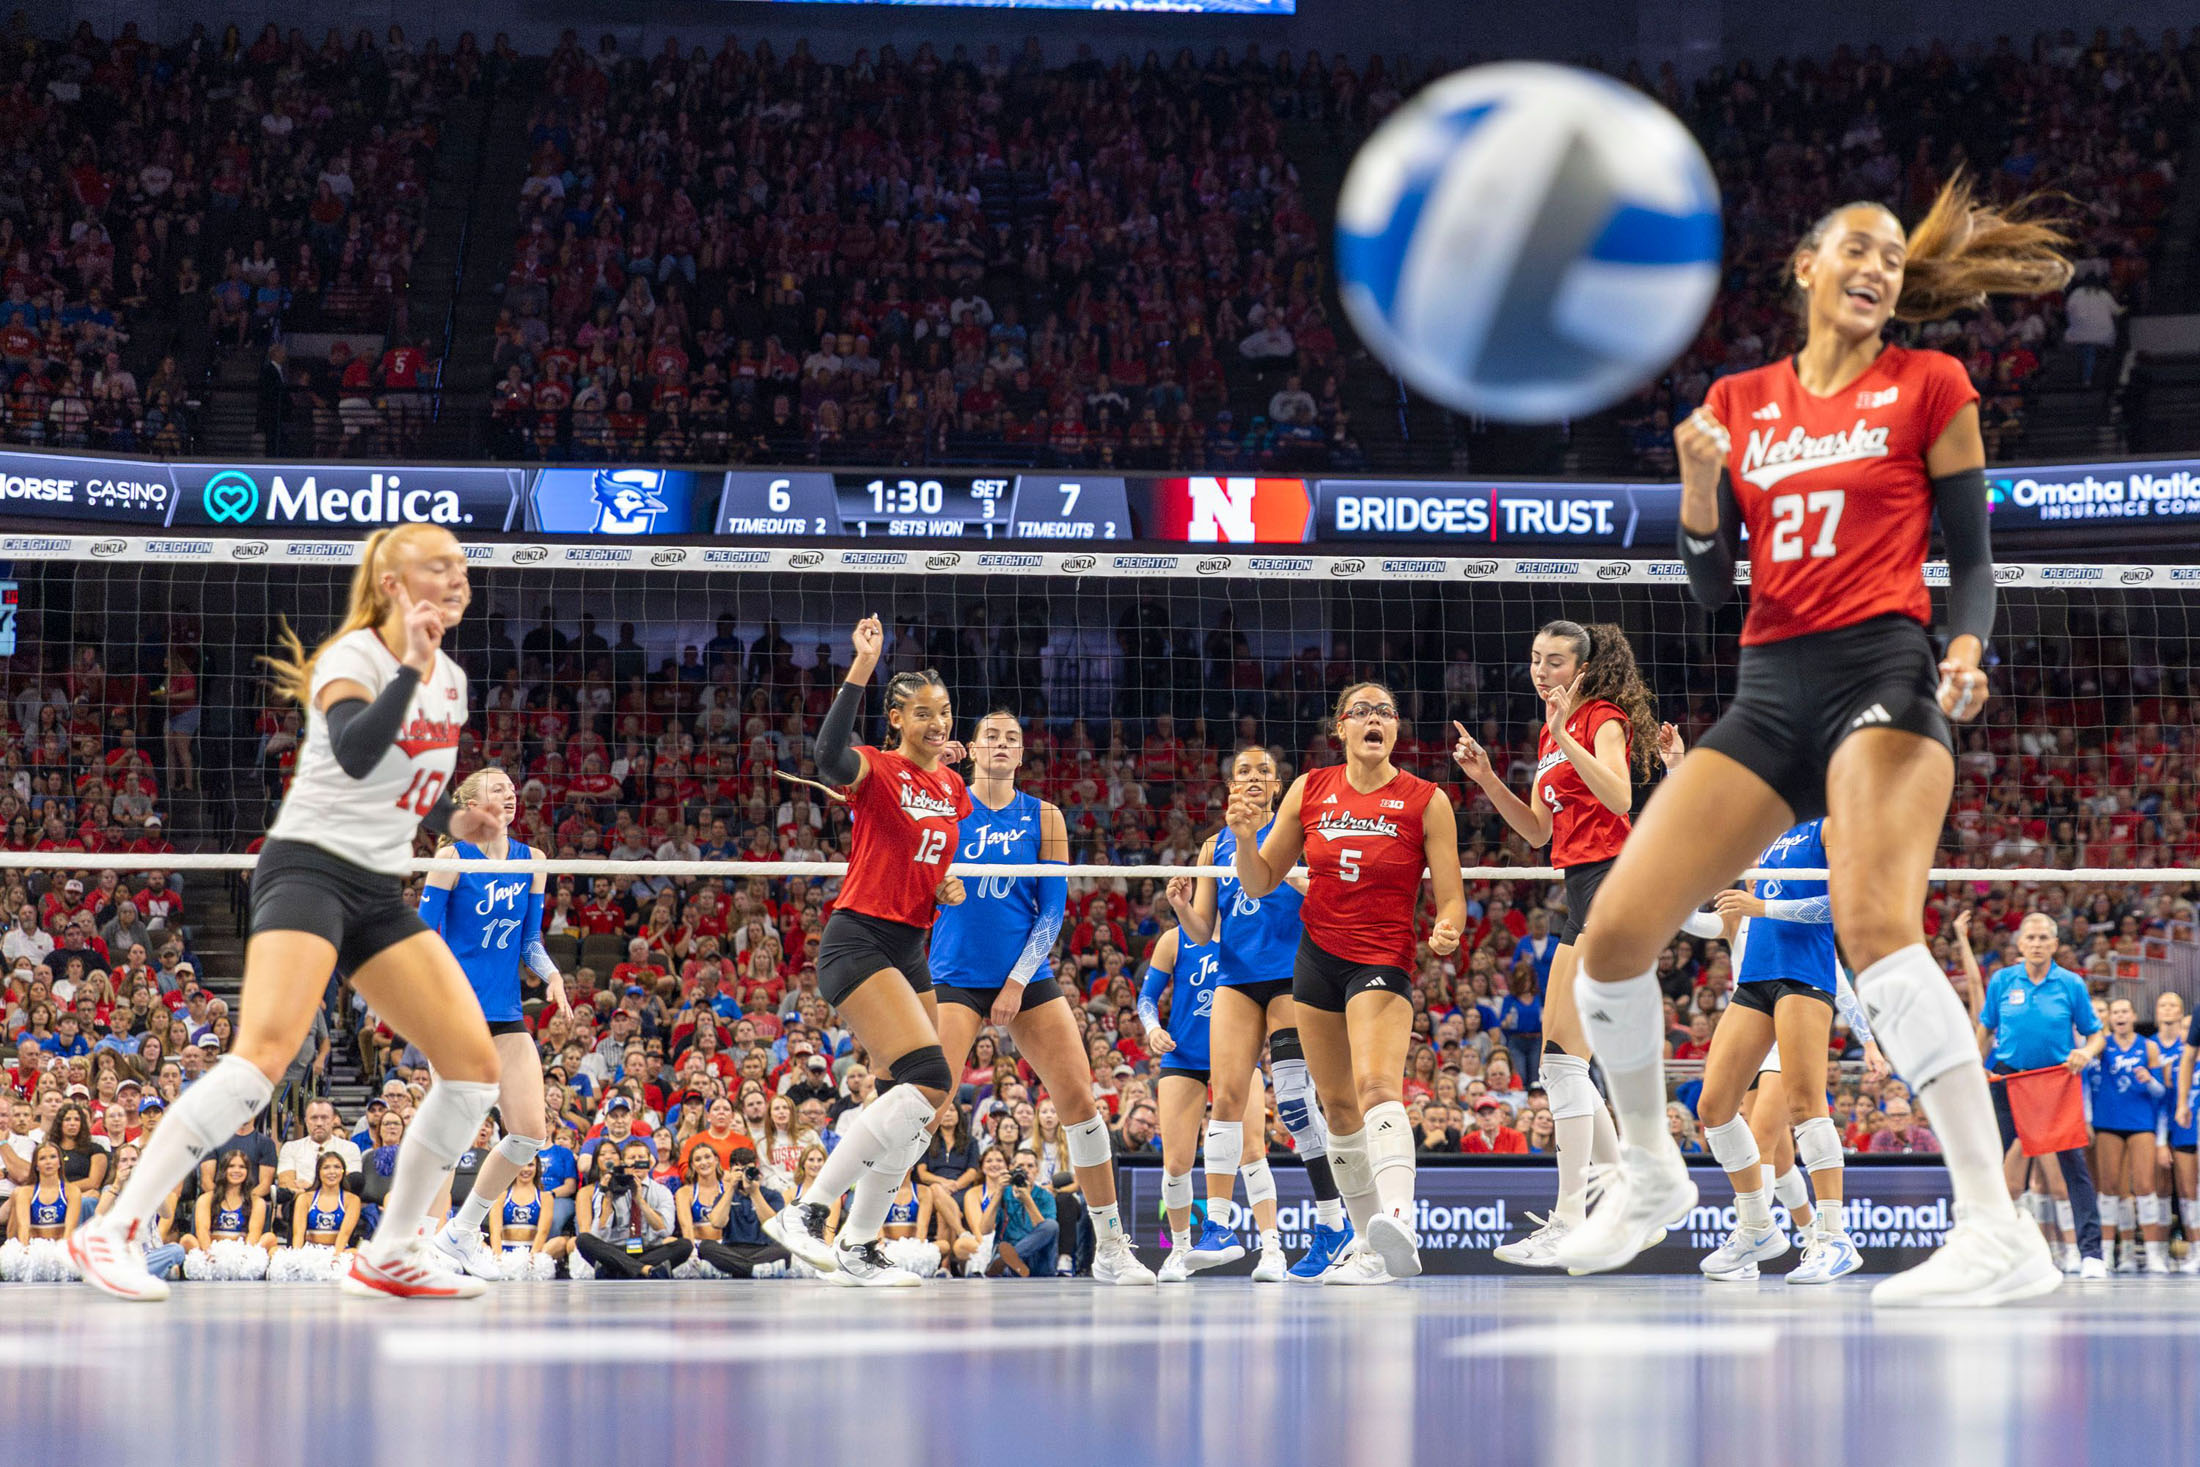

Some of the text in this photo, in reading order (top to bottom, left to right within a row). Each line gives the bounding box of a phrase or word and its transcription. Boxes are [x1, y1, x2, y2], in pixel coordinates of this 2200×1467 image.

[1741, 419, 1889, 473] Nebraska
[86, 480, 167, 502] CASINO
[768, 479, 791, 513] 6
[970, 479, 1008, 499] SET
[2012, 476, 2124, 507] Omaha
[867, 480, 943, 514] 1:30
[1058, 483, 1081, 517] 7
[88, 498, 165, 511] OMAHA
[982, 499, 995, 519] 3
[1188, 477, 1256, 543] N
[2040, 500, 2149, 520] INSURANCE
[1336, 497, 1489, 533] BRIDGES
[728, 518, 827, 535] TIMEOUTS 2
[857, 520, 993, 539] 1 SETS WON 1
[1017, 521, 1116, 539] TIMEOUTS 2
[1772, 489, 1845, 562] 27
[2, 538, 71, 551] CREIGHTON
[94, 543, 124, 554] RUNZA
[145, 540, 213, 554] CREIGHTON
[235, 545, 265, 556] RUNZA
[286, 543, 354, 556] CREIGHTON
[515, 550, 545, 561] RUNZA
[565, 548, 632, 561] CREIGHTON
[654, 552, 683, 563] RUNZA
[704, 550, 770, 563] CREIGHTON
[792, 554, 821, 565] RUNZA
[841, 552, 907, 565] CREIGHTON
[929, 556, 957, 567] RUNZA
[977, 554, 1043, 567] CREIGHTON
[1065, 559, 1093, 569] RUNZA
[1112, 557, 1178, 569] CREIGHTON
[1200, 560, 1228, 571] RUNZA
[1248, 558, 1313, 571] CREIGHTON
[1334, 562, 1362, 573] RUNZA
[1381, 560, 1446, 573] CREIGHTON
[1467, 564, 1495, 575] RUNZA
[1515, 562, 1579, 574] CREIGHTON
[1600, 566, 1628, 576] RUNZA
[1994, 569, 2021, 580] RUNZA
[2040, 568, 2103, 580] CREIGHTON
[2124, 570, 2151, 581] RUNZA
[396, 768, 445, 817] 10
[1317, 810, 1398, 837] Nebraska
[914, 828, 947, 864] 12
[964, 824, 1027, 860] Jays
[1760, 834, 1809, 864] Jays
[1339, 848, 1362, 882] 5
[475, 879, 527, 915] Jays
[481, 918, 521, 949] 17
[1415, 1233, 1505, 1249] OMPANY
[1851, 1232, 1947, 1248] OMPANY
